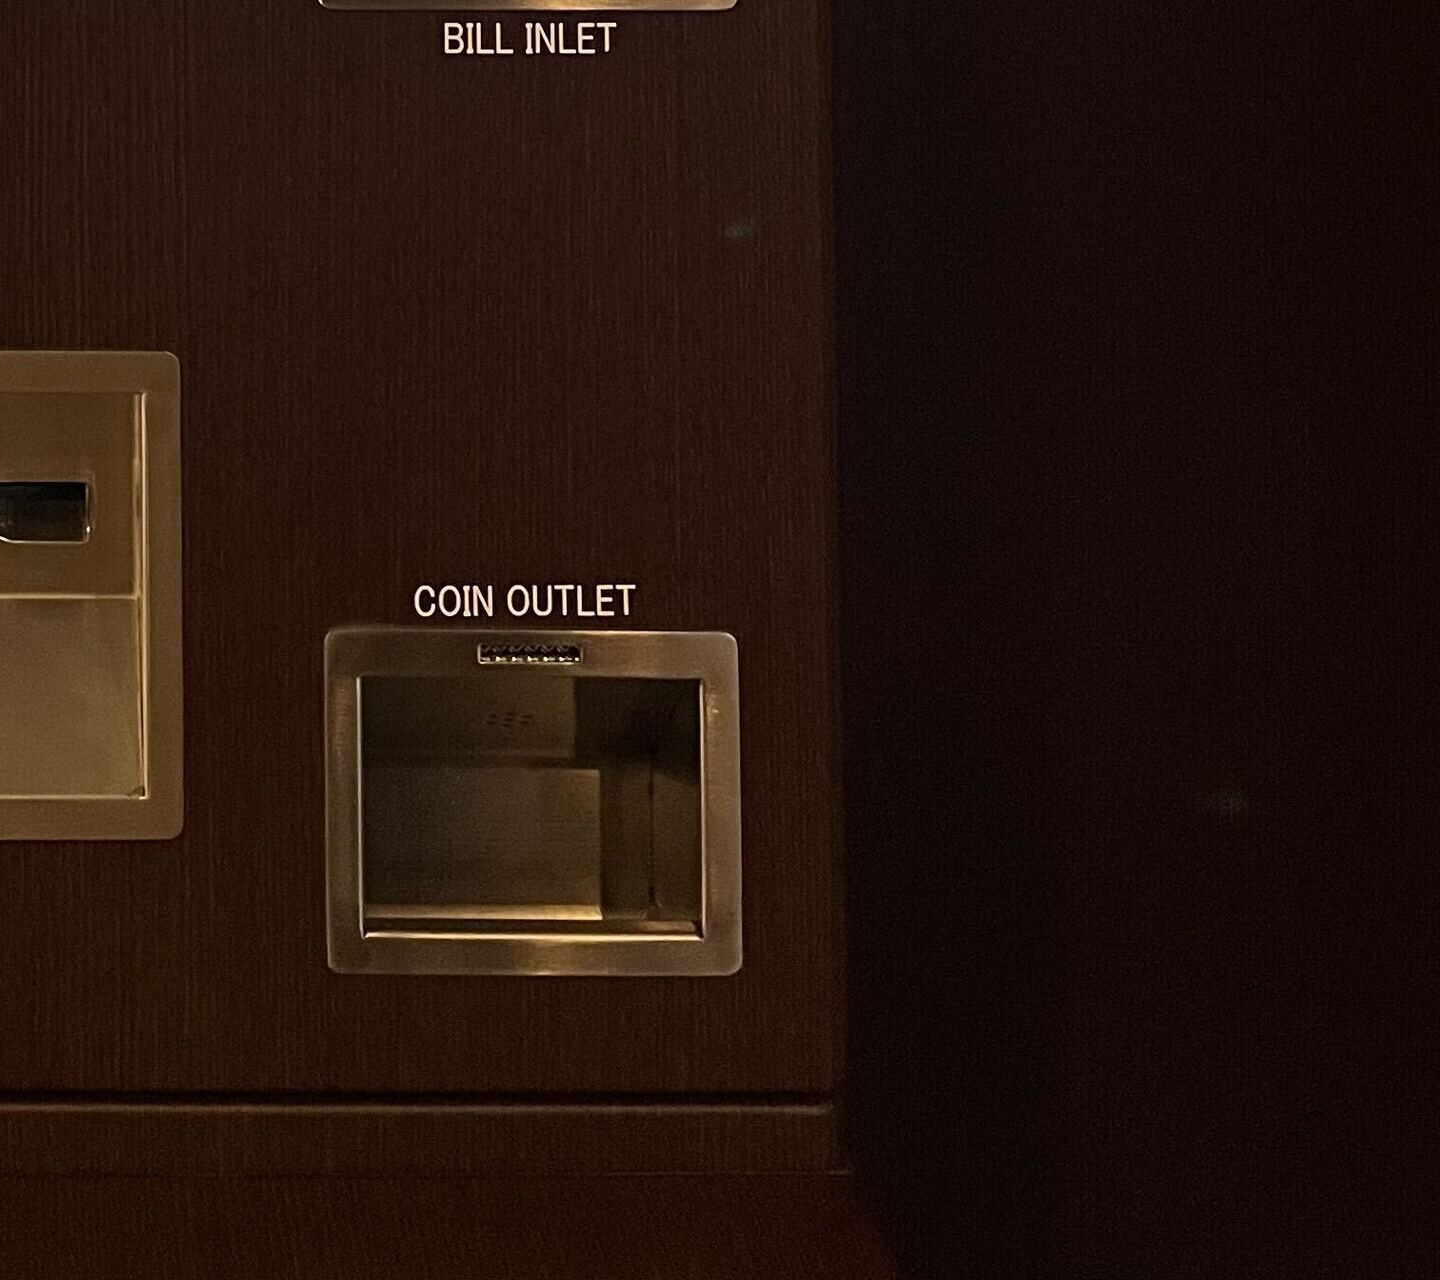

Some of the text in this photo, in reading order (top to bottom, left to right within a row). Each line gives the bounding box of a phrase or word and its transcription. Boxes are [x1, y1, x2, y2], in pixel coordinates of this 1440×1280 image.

[444, 22, 617, 54] BILL INLET
[413, 584, 636, 617] COIN OUTLET
